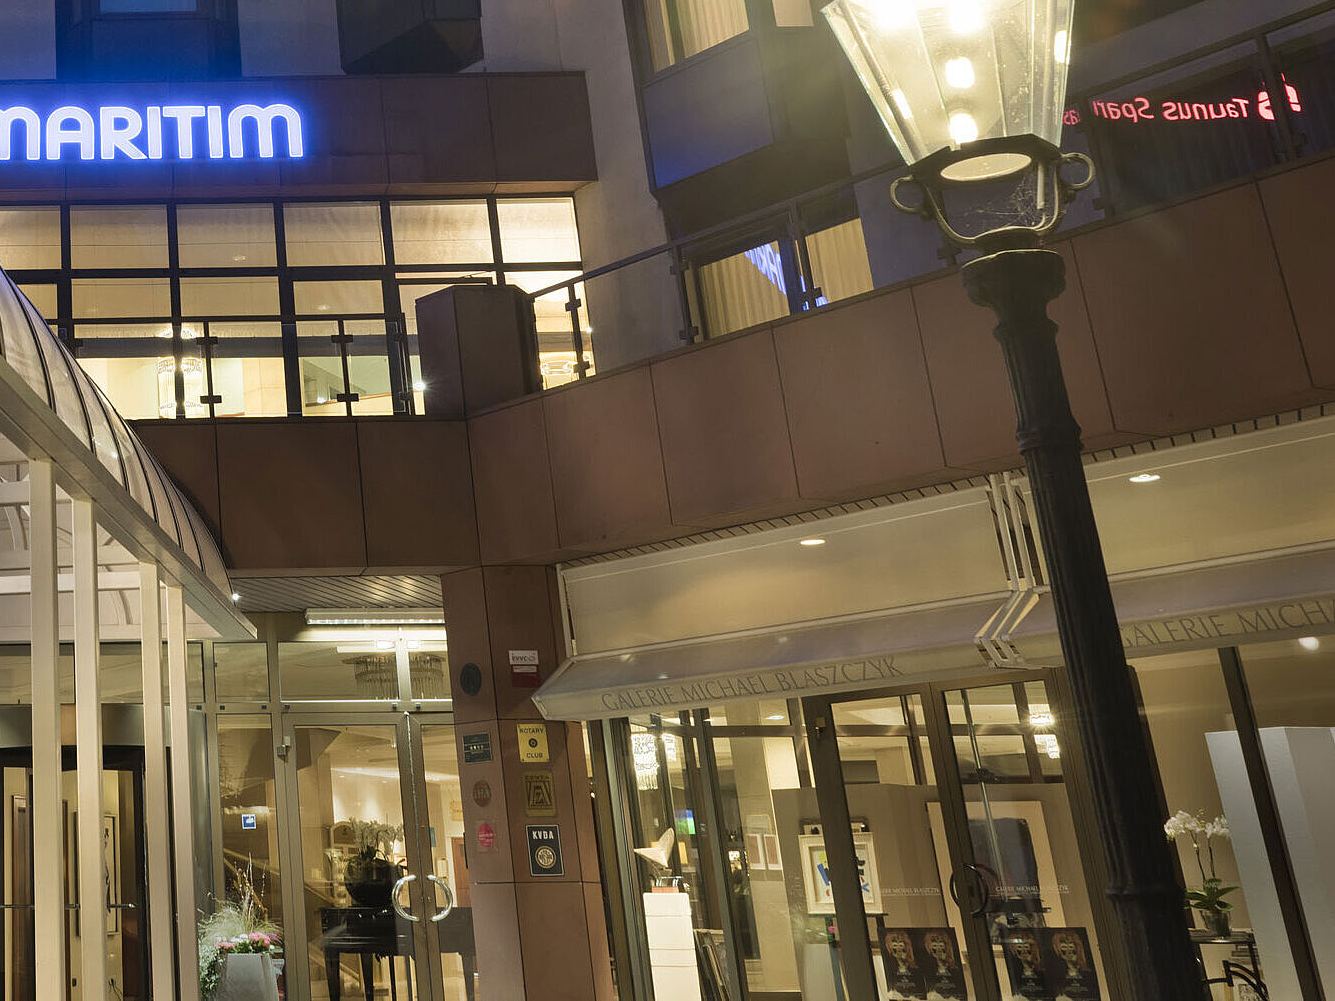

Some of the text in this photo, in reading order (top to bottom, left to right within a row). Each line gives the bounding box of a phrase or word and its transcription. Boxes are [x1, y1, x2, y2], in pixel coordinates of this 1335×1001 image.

[1237, 599, 1335, 633] MICH
[602, 655, 907, 711] GALERIE MICHAEL BLASZCZYK
[532, 830, 554, 840] KVDA
